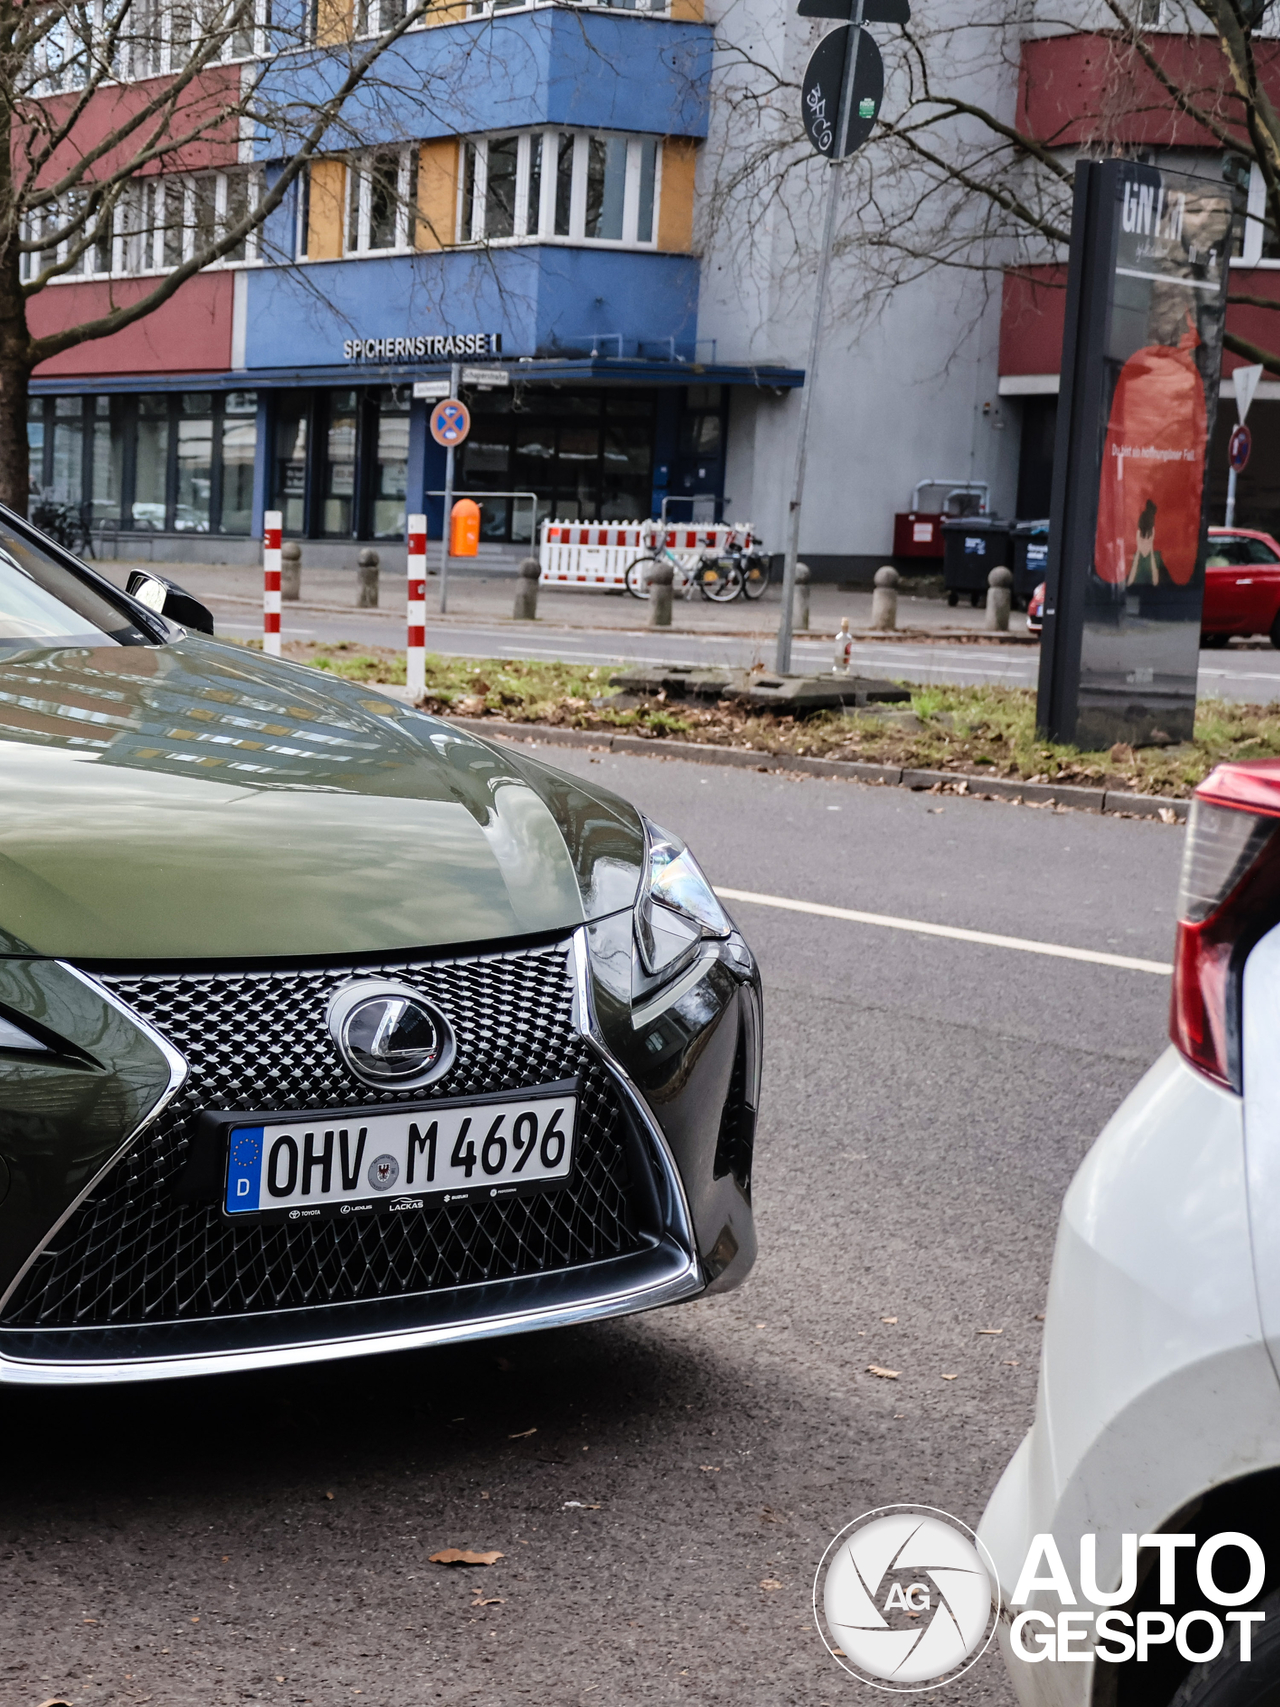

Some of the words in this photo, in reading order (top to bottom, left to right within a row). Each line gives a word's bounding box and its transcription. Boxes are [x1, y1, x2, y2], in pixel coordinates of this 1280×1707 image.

[343, 333, 486, 359] SPICHERNSTRASSE
[267, 1126, 368, 1197] OHV
[406, 1120, 439, 1184] M
[450, 1108, 566, 1178] 4696
[236, 1178, 250, 1196] D
[301, 1209, 321, 1217] TOYOTA
[389, 1201, 424, 1212] LACKAS
